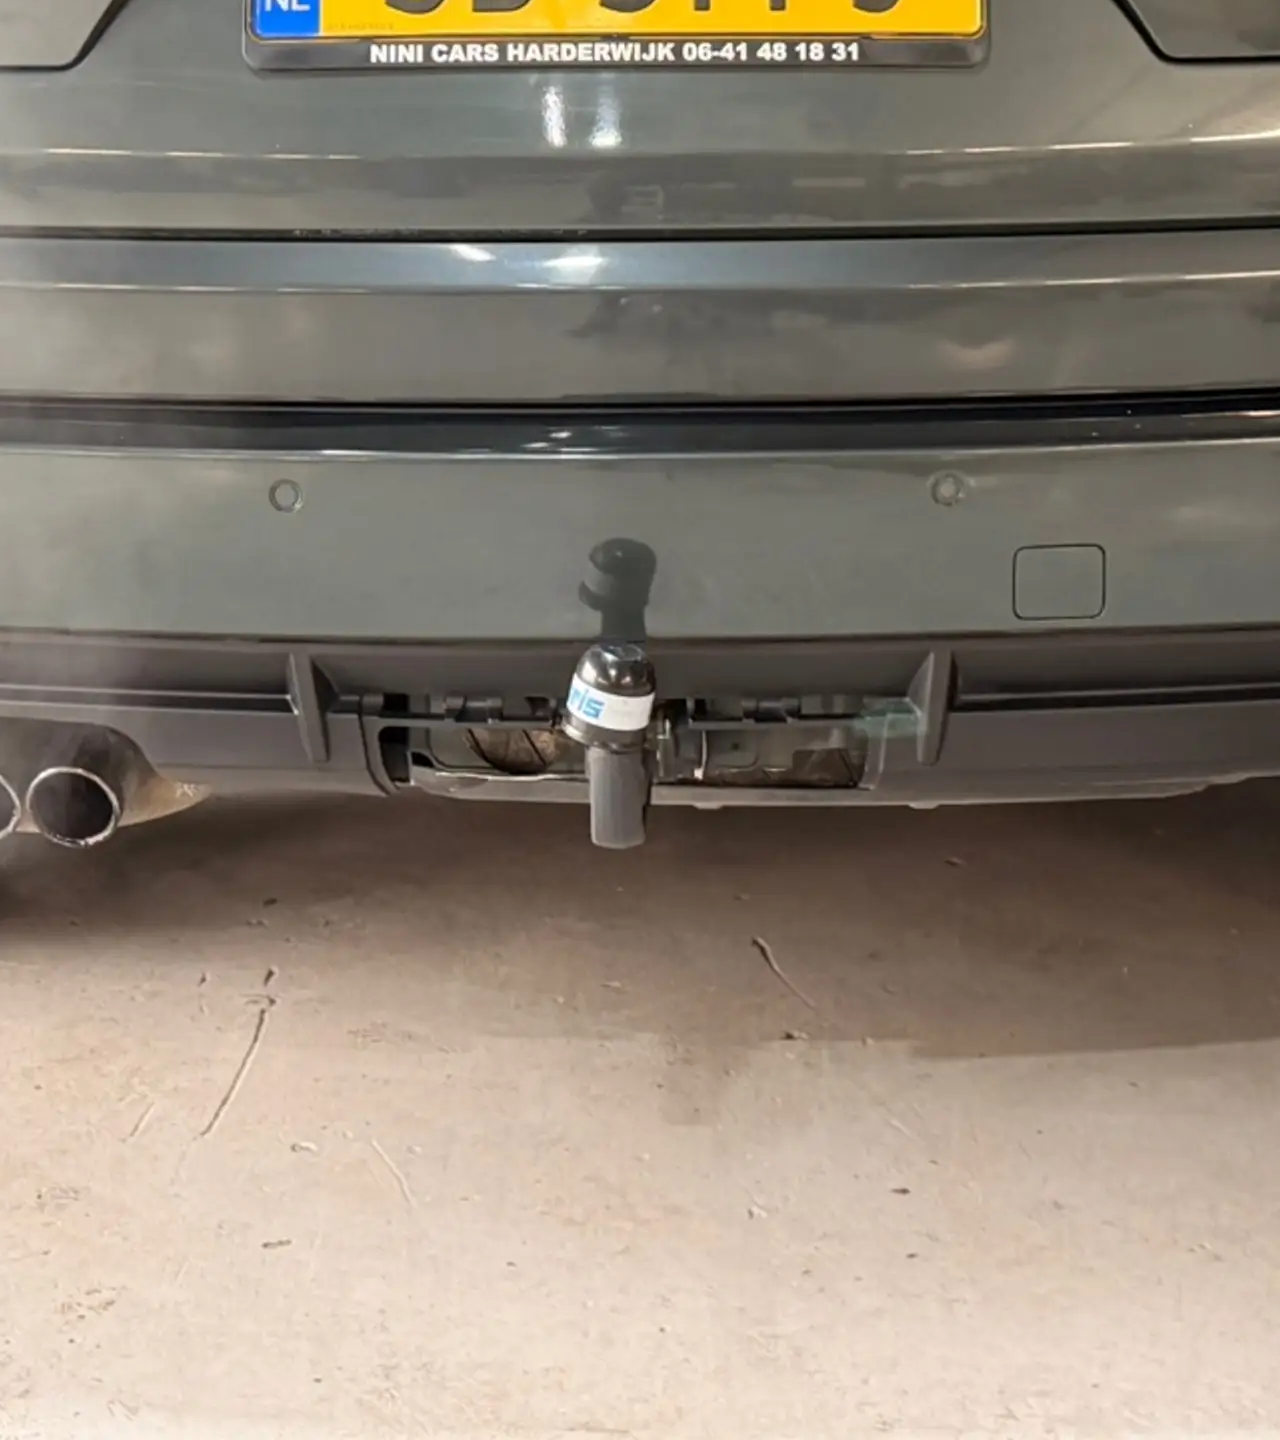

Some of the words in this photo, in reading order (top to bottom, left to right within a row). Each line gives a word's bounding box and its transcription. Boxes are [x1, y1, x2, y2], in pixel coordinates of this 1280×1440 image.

[370, 43, 423, 63] NINI
[431, 42, 500, 62] CARS
[507, 42, 676, 62] HARDERWIJK
[682, 41, 748, 61] 06-41
[756, 41, 787, 61] 48
[795, 41, 825, 61] 18
[831, 41, 860, 61] 31
